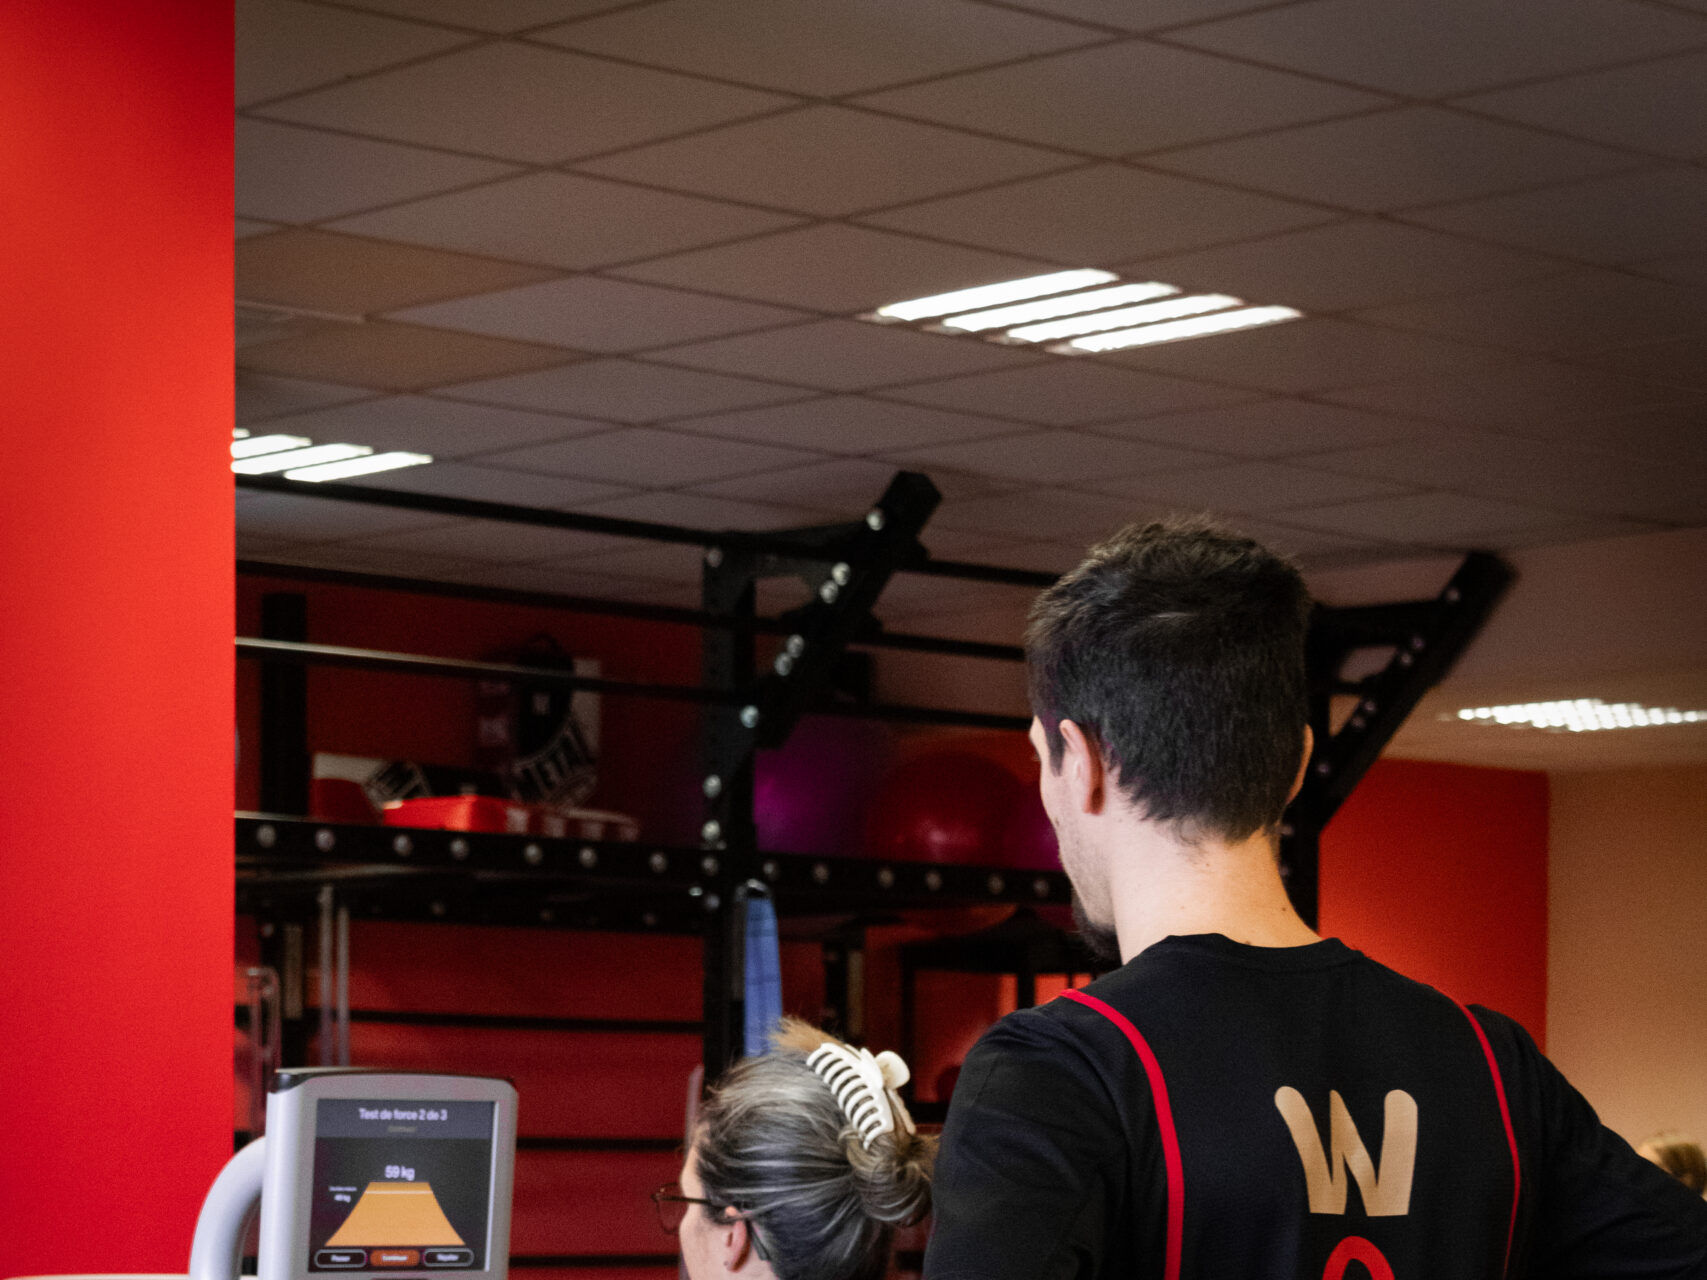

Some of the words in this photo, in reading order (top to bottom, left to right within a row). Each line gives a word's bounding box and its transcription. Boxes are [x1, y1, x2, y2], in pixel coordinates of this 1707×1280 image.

[358, 1107, 379, 1120] Test
[379, 1109, 392, 1120] de
[393, 1109, 418, 1121] force
[419, 1109, 426, 1121] 2
[426, 1109, 440, 1121] de
[440, 1109, 448, 1122] 3
[401, 1165, 416, 1182] kg
